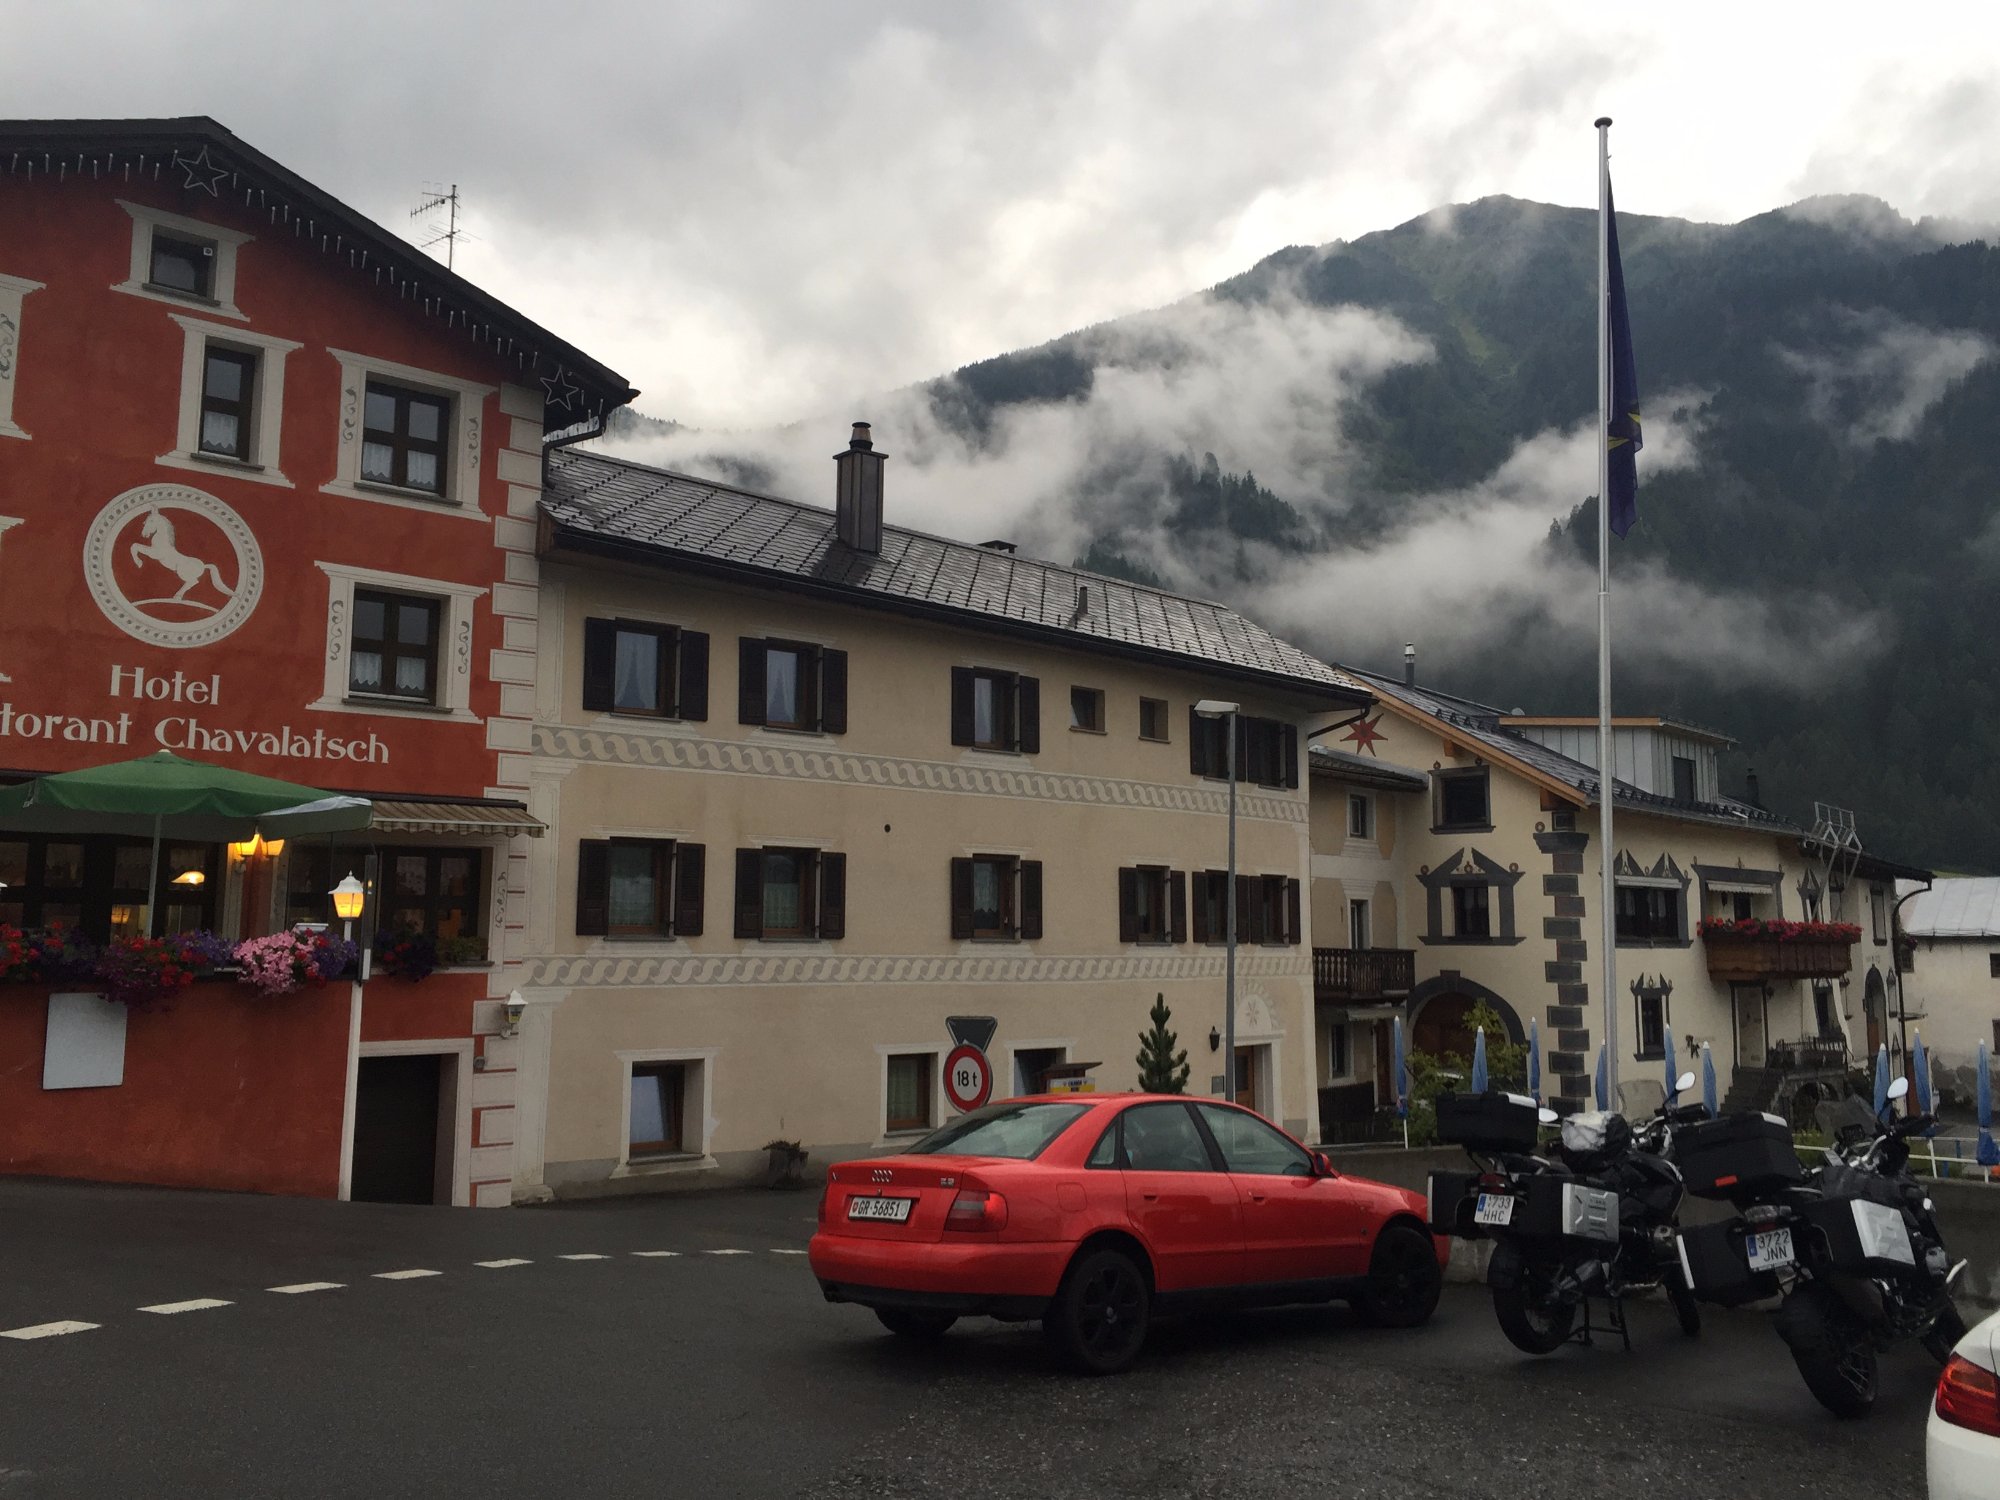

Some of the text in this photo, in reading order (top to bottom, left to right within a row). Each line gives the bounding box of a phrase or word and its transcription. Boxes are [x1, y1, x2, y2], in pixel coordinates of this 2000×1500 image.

[109, 664, 220, 706] Hotel
[154, 716, 390, 765] Chavalatsch
[957, 1070, 978, 1087] 18 t
[1757, 1230, 1790, 1249] 3722
[1763, 1245, 1787, 1262] JNN
